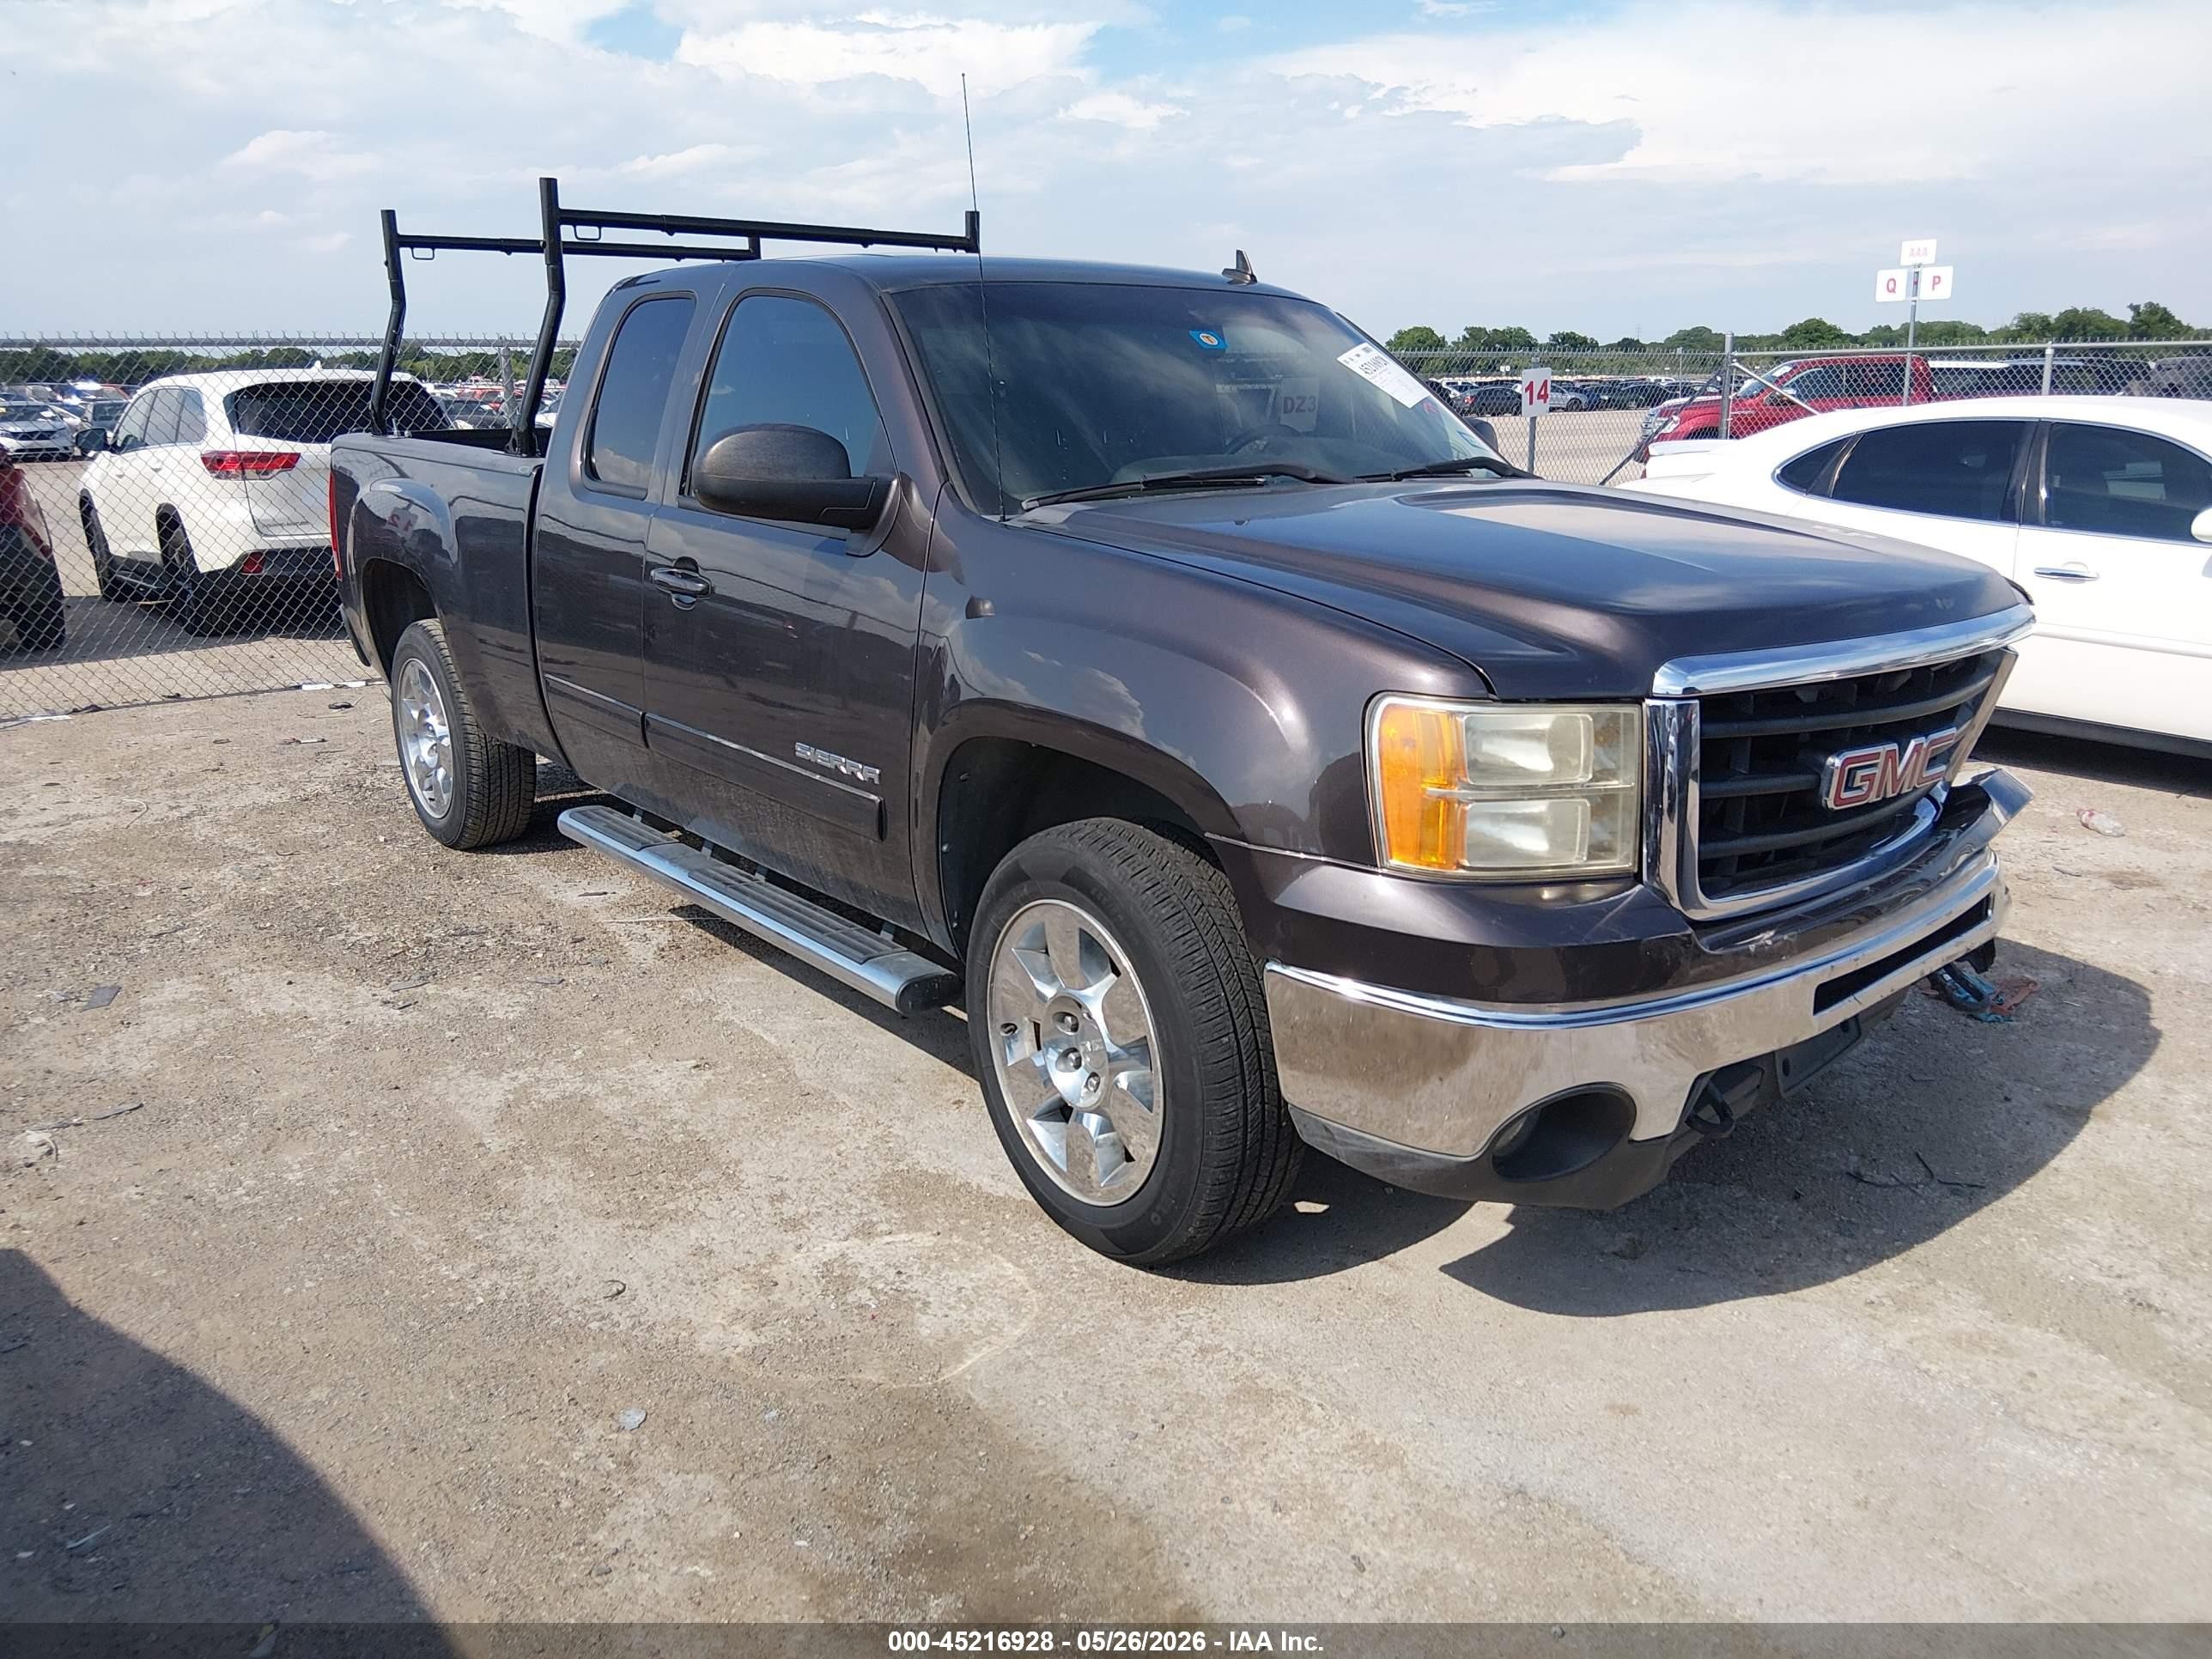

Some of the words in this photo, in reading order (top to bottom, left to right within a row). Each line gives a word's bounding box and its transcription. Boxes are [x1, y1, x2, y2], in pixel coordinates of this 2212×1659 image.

[1886, 277, 1897, 294] Q
[1932, 275, 1942, 291] P
[1524, 379, 1549, 405] 14
[1283, 396, 1317, 414] DZ3
[794, 742, 880, 784] SIERRA
[1826, 727, 1957, 810] GMC
